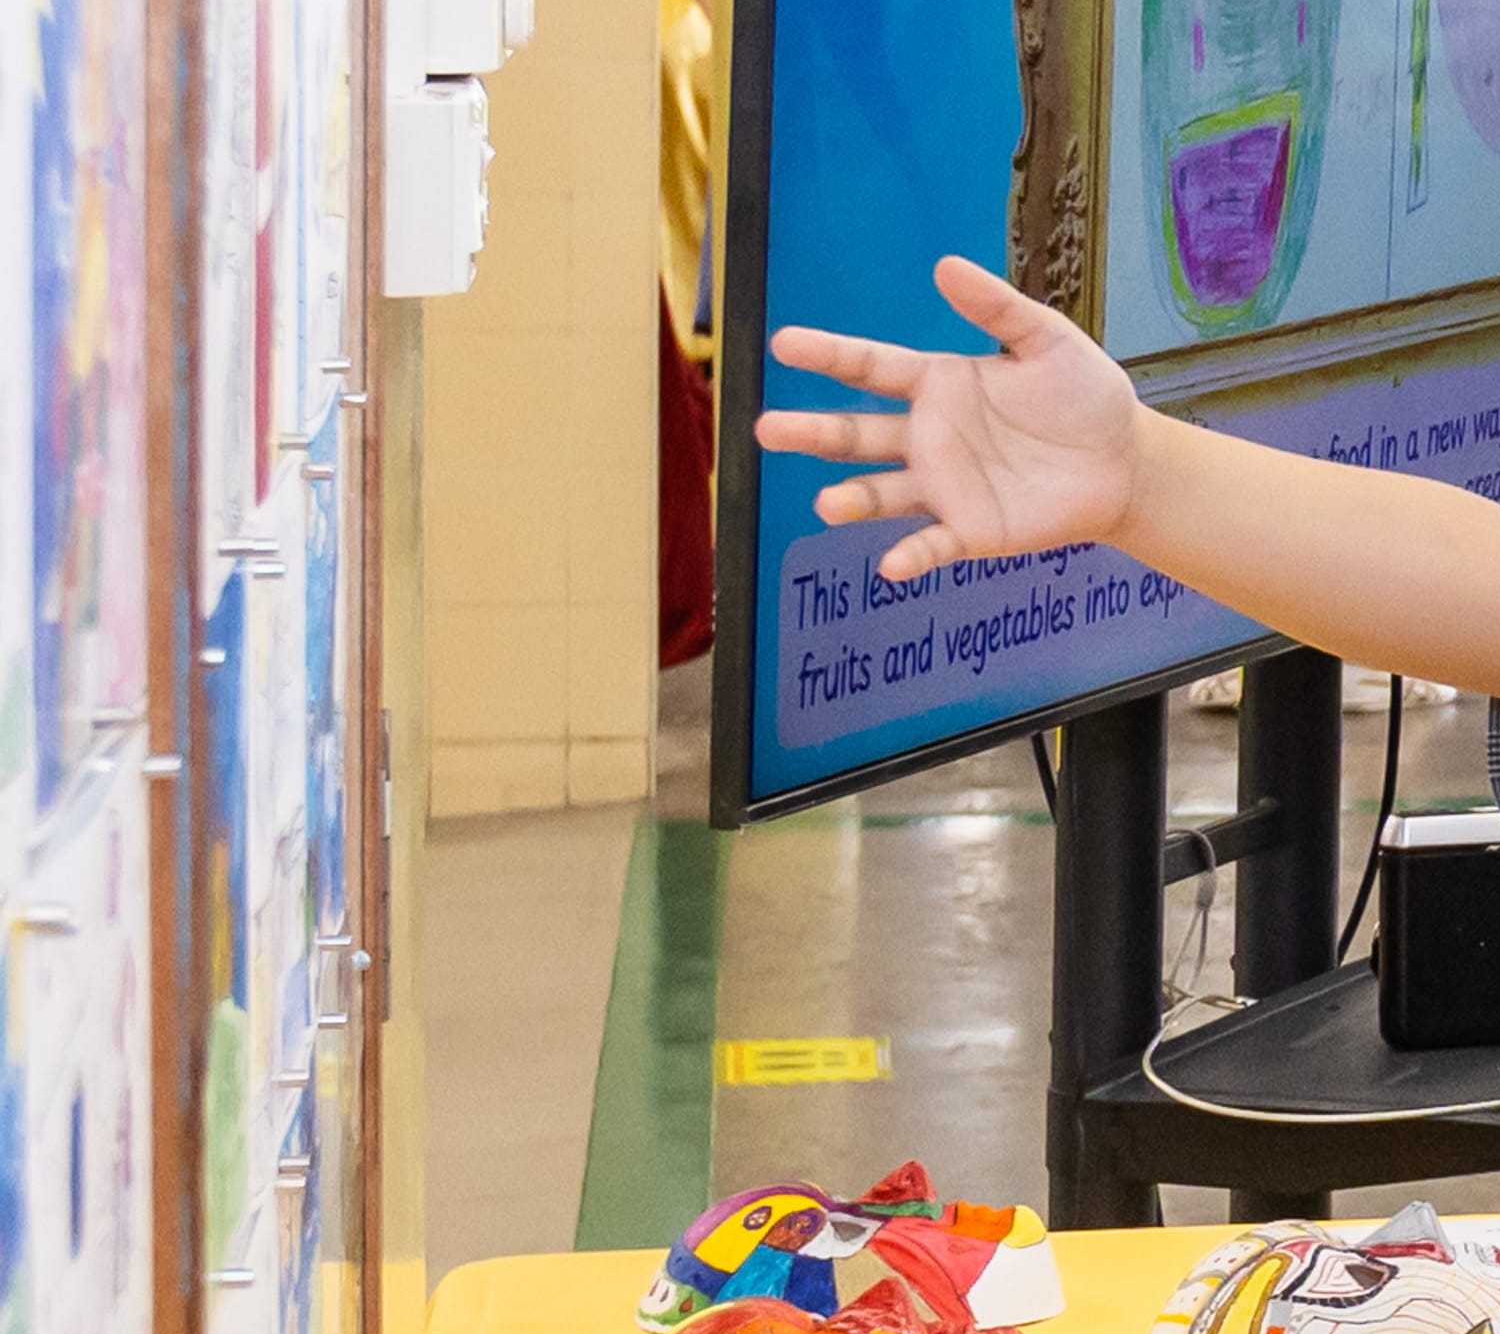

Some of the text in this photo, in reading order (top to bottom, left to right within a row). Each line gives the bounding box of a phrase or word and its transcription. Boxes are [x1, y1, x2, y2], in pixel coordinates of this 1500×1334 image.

[793, 573, 849, 631] This
[862, 556, 941, 613] lesson
[1328, 425, 1372, 468] food
[1380, 425, 1398, 468] in
[1406, 430, 1419, 462] a
[1427, 416, 1467, 457] new
[798, 644, 873, 710] fruits
[883, 617, 934, 685] and
[945, 583, 1075, 675] vegetables
[1085, 573, 1130, 625] into
